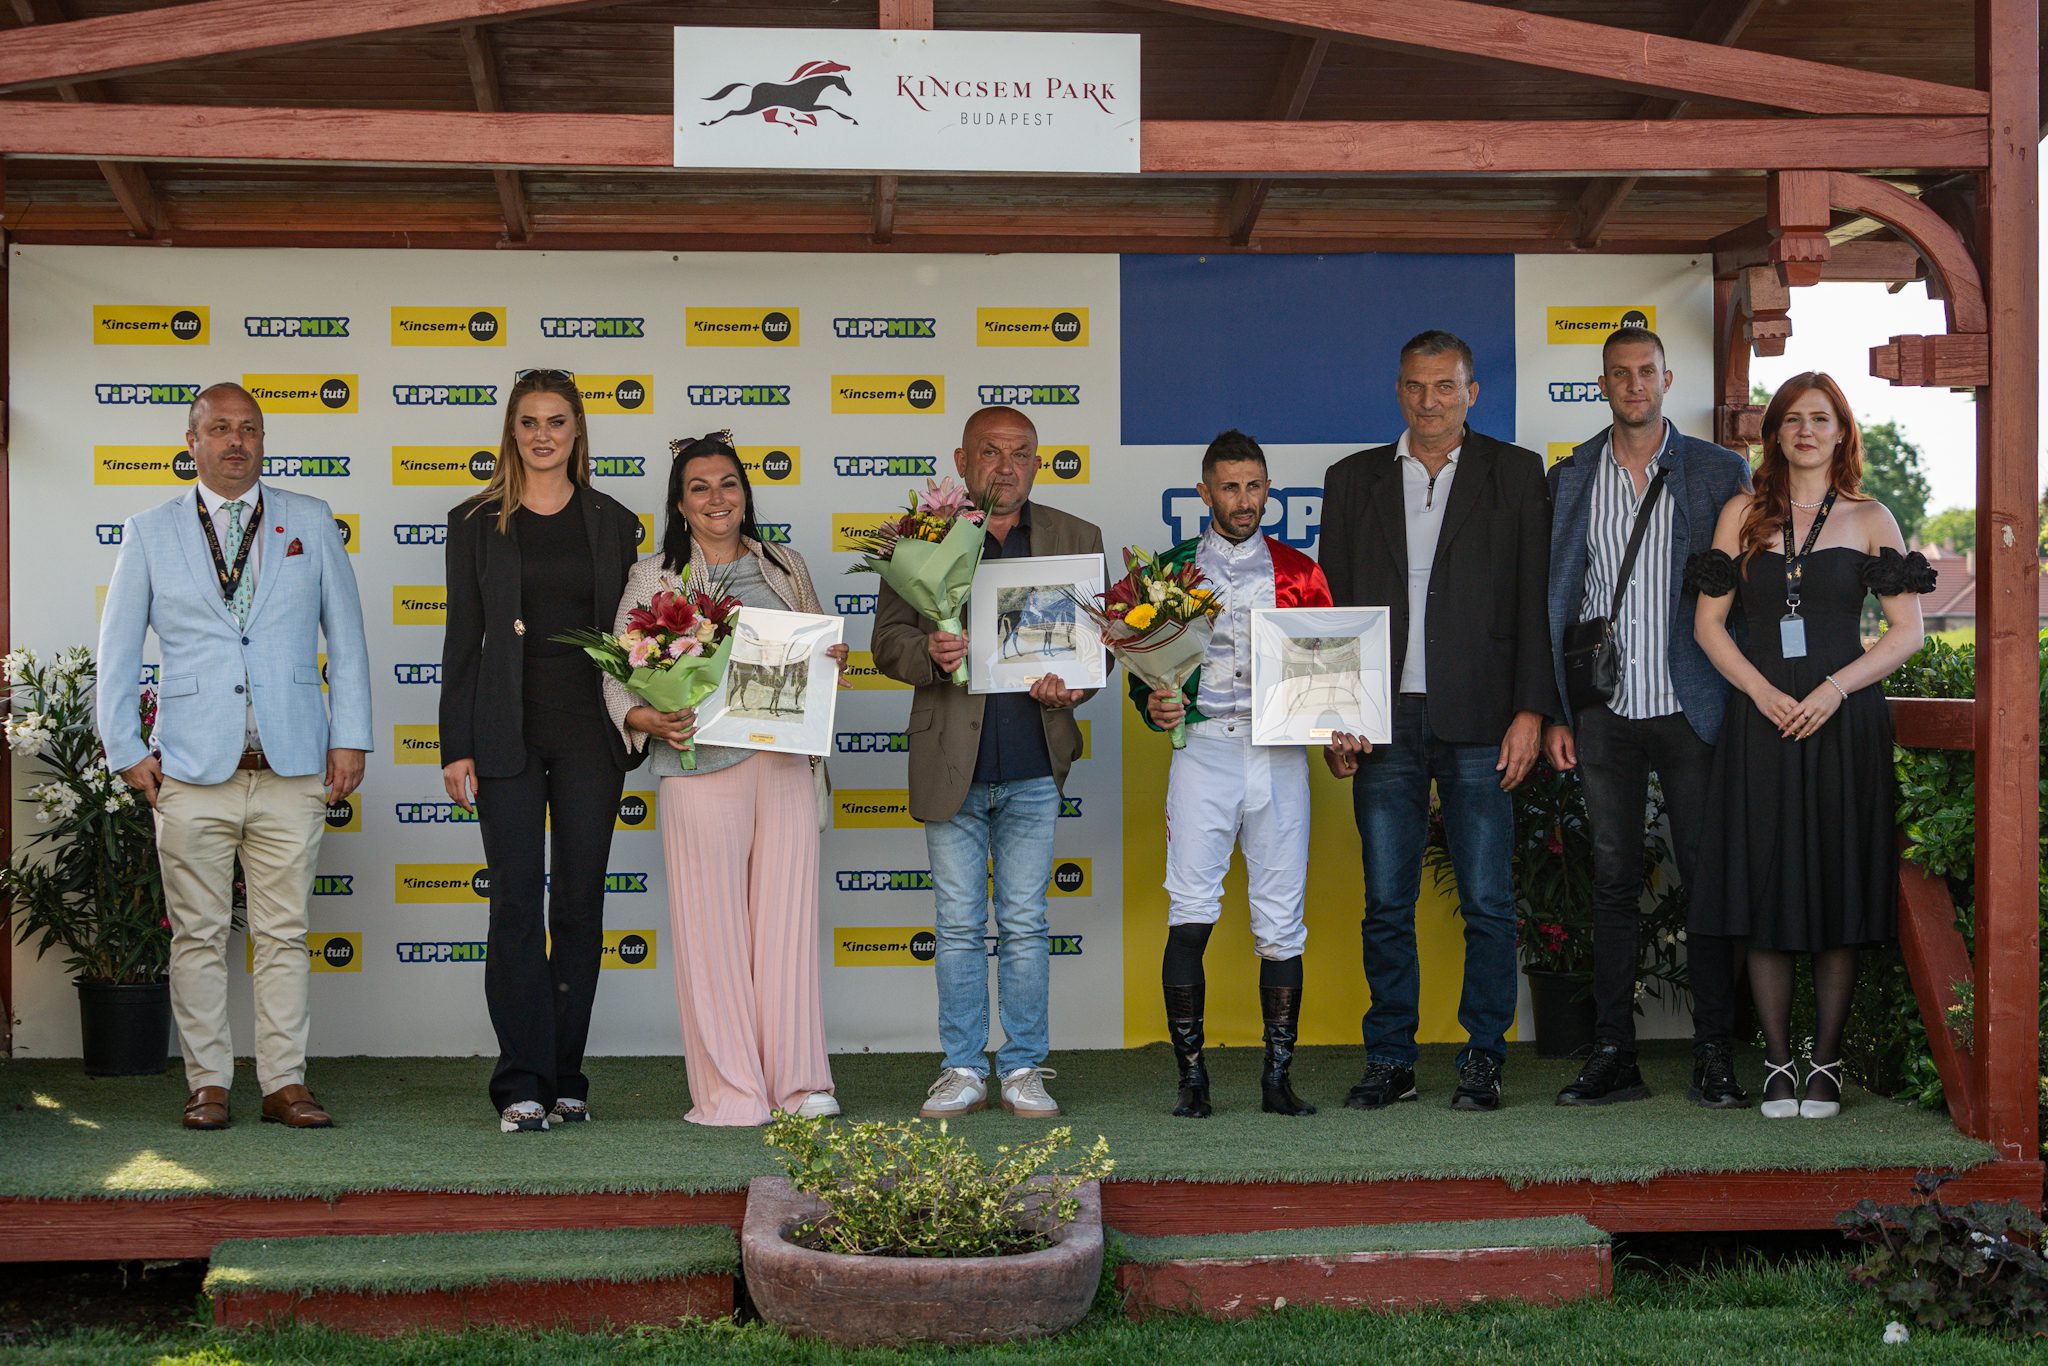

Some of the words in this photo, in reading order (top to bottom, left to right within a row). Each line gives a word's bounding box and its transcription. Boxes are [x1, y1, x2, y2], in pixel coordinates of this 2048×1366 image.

[896, 75, 1032, 111] KINCSEM
[1046, 77, 1117, 114] PARK
[960, 112, 1054, 127] BUDAPEST
[173, 319, 198, 331] tuti
[471, 320, 495, 332] tuti
[764, 321, 788, 333] tuti
[1054, 321, 1078, 333] tuti
[322, 388, 347, 399] tuti
[618, 388, 641, 400] tuti
[909, 388, 933, 400] tuti
[262, 457, 350, 475] iPPMIX
[471, 460, 496, 471] tuti
[765, 460, 789, 471] tuti
[1055, 459, 1078, 470] tuti
[395, 525, 447, 544] TiPP
[401, 599, 446, 610] Kincse
[403, 738, 439, 749] Kincs
[837, 733, 908, 752] TiPPM
[620, 804, 644, 816] tuti
[1057, 871, 1080, 883] tuti
[326, 946, 350, 958] tuti
[621, 943, 644, 955] tuti
